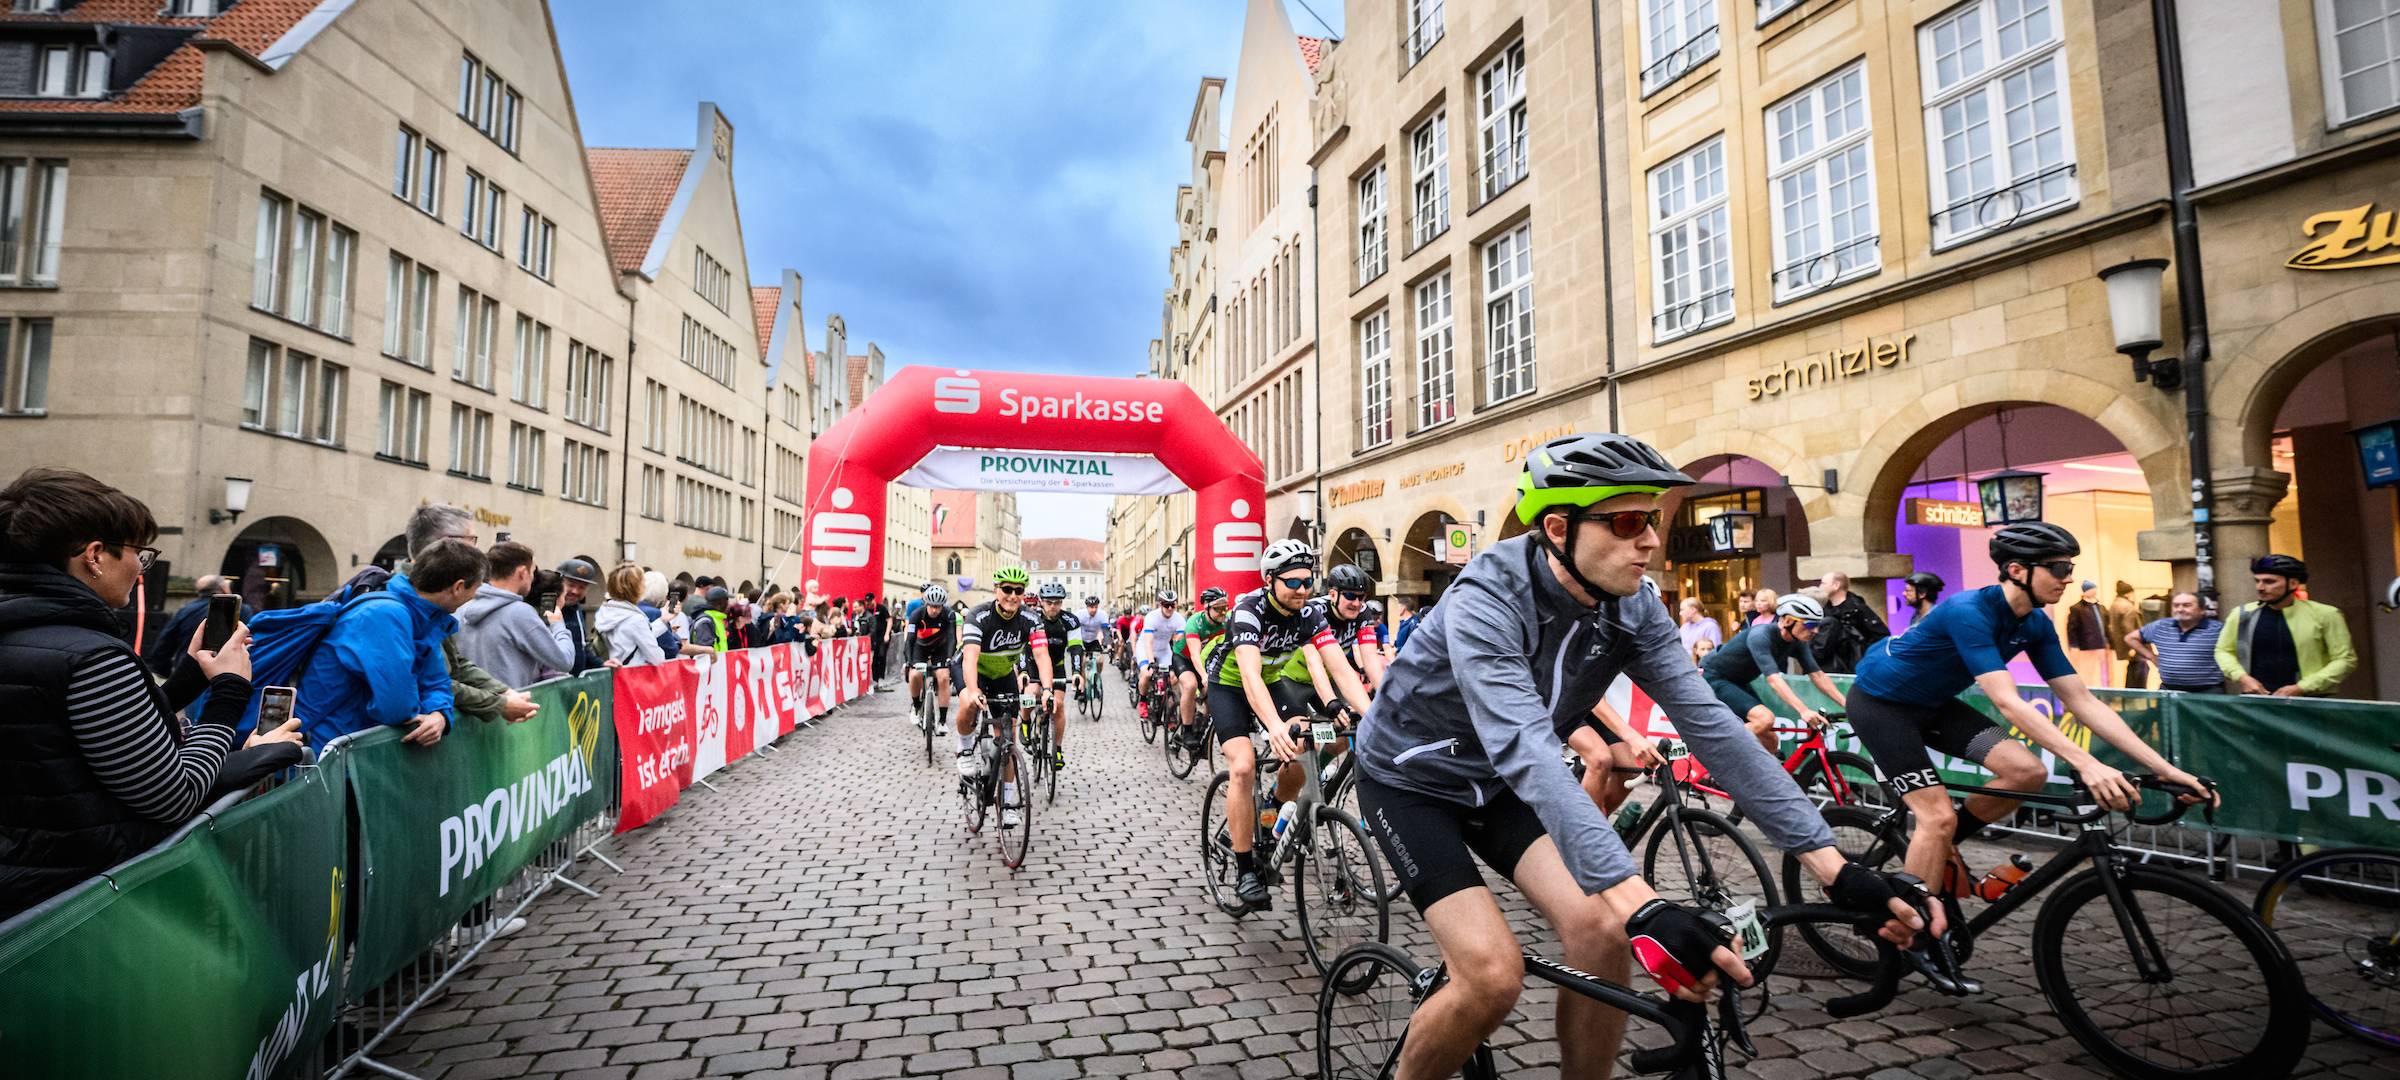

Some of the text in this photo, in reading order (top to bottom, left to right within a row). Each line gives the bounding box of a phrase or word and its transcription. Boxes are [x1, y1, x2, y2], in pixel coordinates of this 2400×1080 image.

[1748, 334, 1916, 401] schnitzler
[999, 388, 1164, 424] Sparkasse
[981, 456, 1114, 477] PROVINZIAL
[980, 477, 994, 485] Die
[995, 477, 1046, 488] Versicherung
[1048, 479, 1061, 487] der
[1071, 479, 1115, 489] Sparkassen
[1399, 474, 1420, 490] HAUS
[1925, 504, 1984, 526] schnitzler
[2286, 762, 2400, 821] PR
[440, 744, 593, 898] PROVINZIAL
